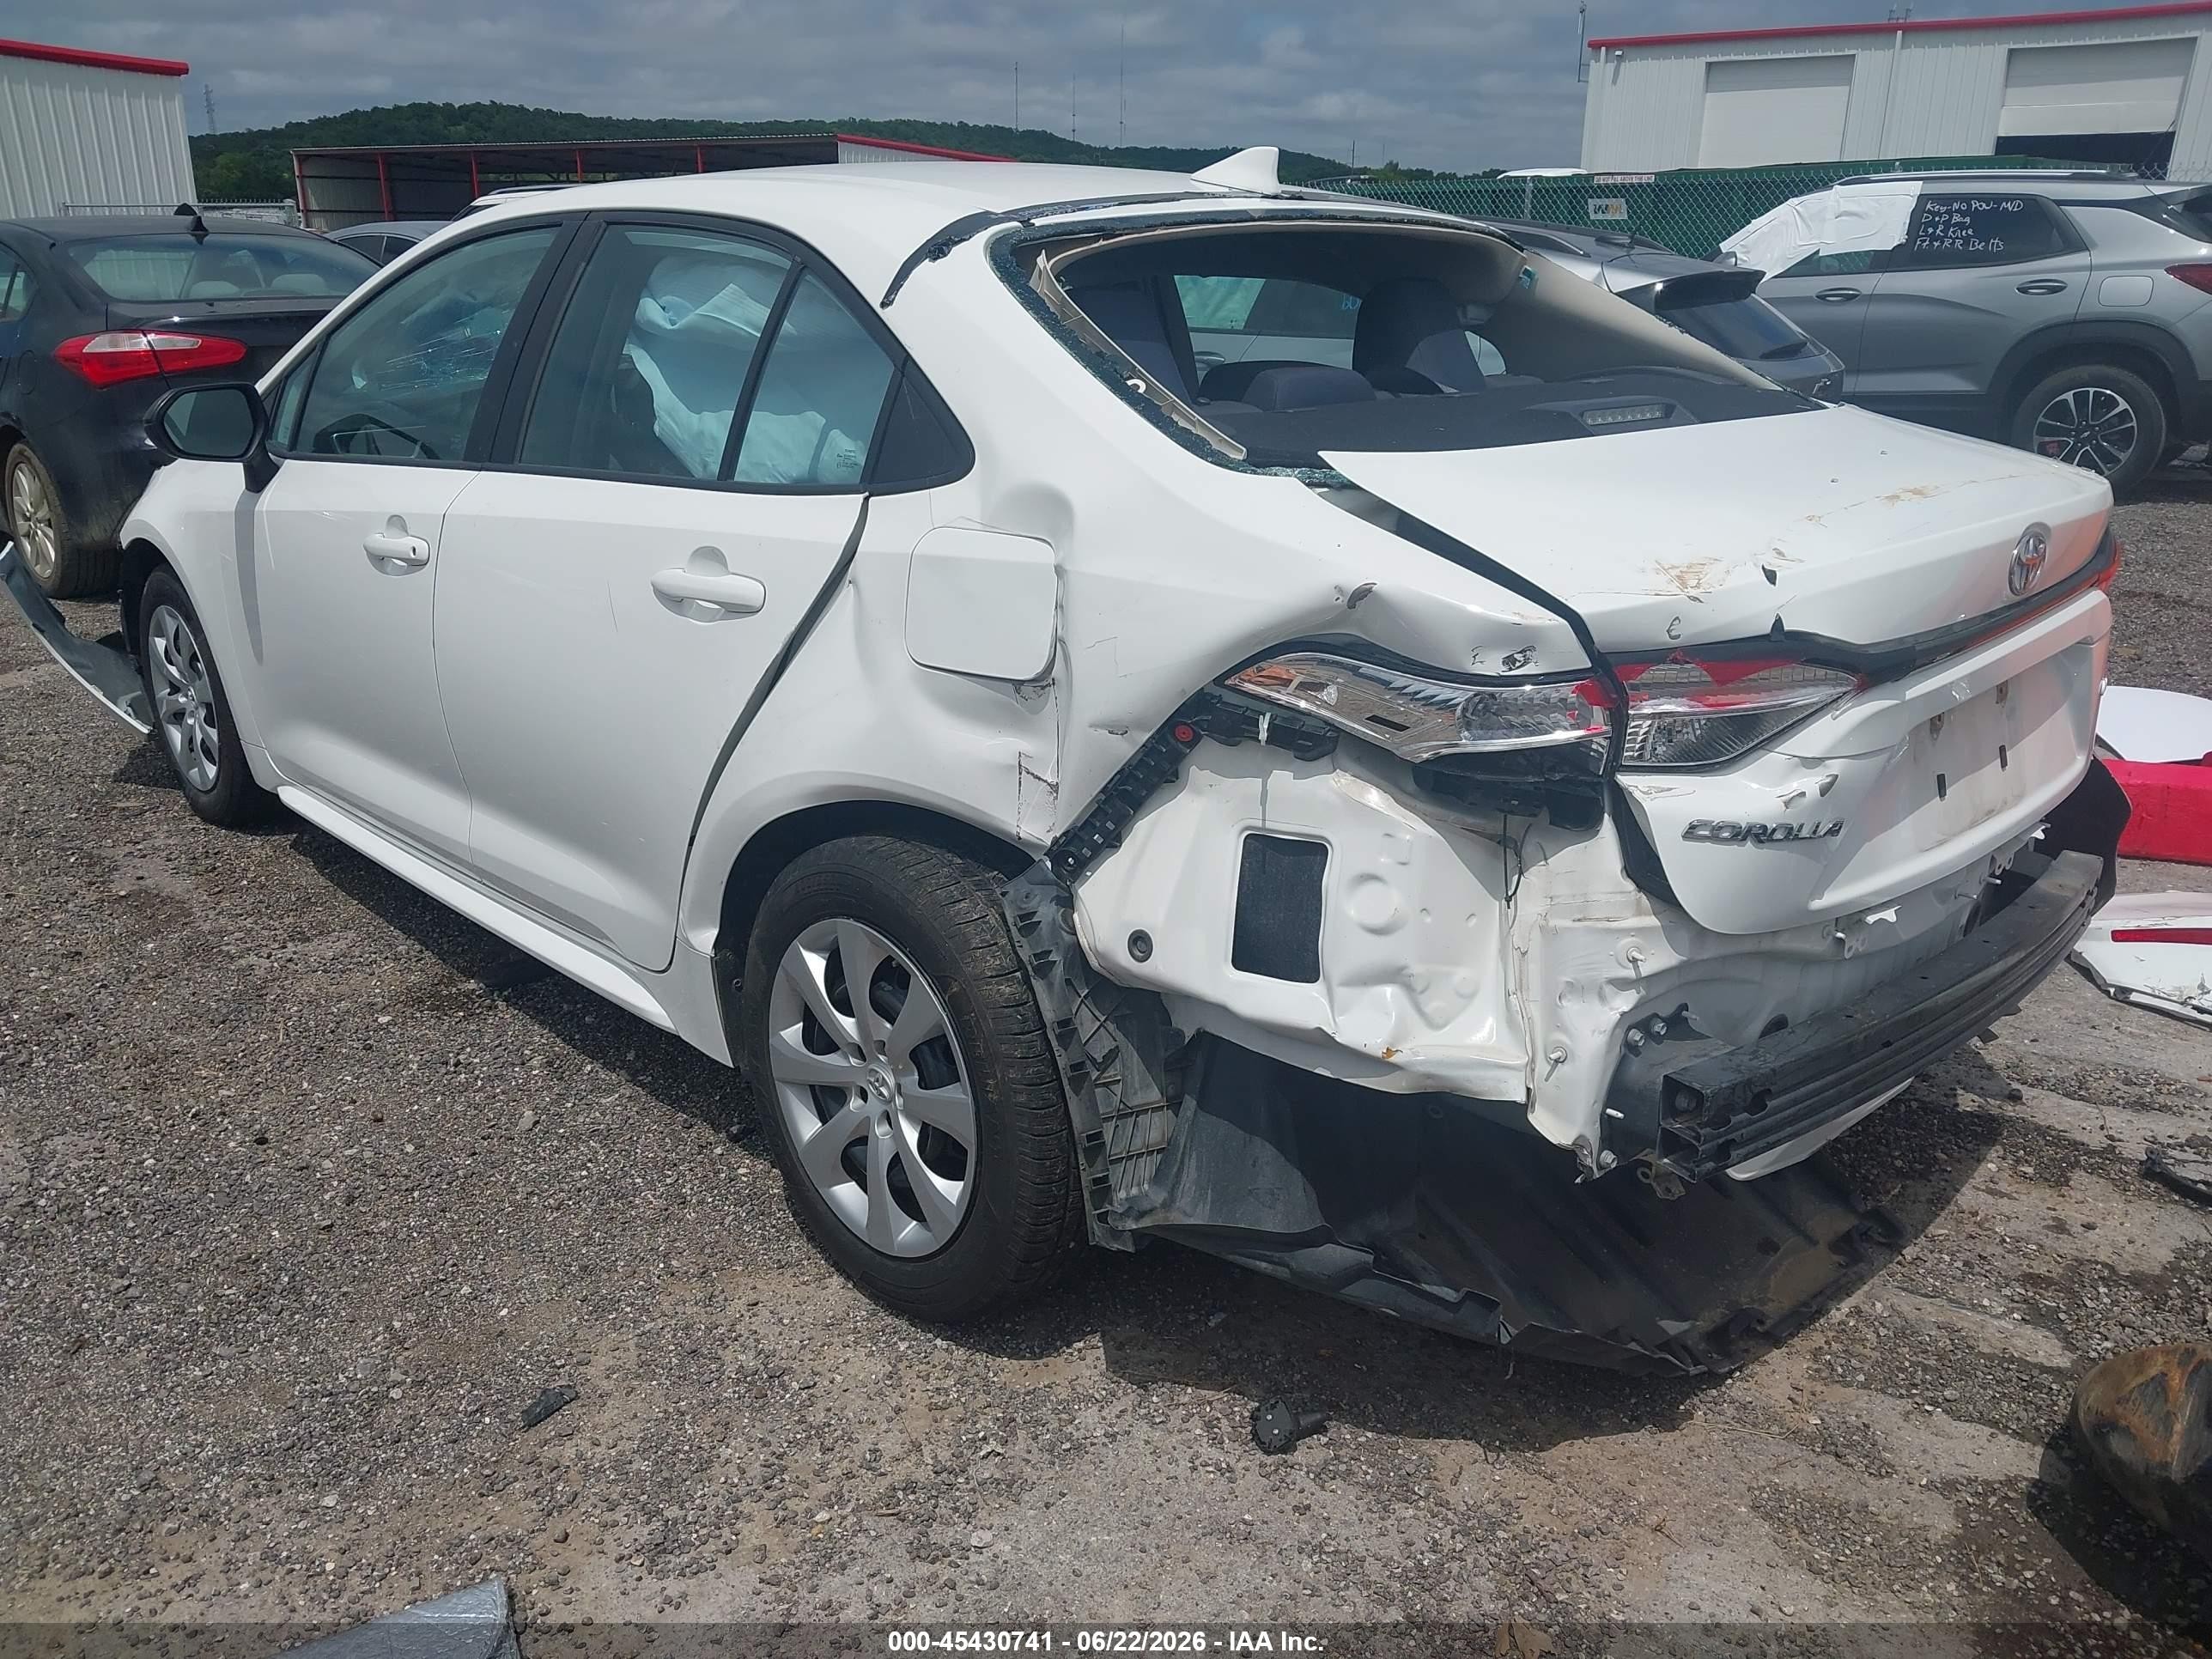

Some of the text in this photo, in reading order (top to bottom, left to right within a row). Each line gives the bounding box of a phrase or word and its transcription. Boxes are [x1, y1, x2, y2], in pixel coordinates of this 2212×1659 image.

[1921, 212, 1933, 222] D
[1951, 212, 1971, 226] Bag
[1918, 224, 1925, 235] L
[1936, 224, 1945, 236] R
[1948, 226, 1975, 239] Knee
[1681, 818, 1846, 845] COROLLA
